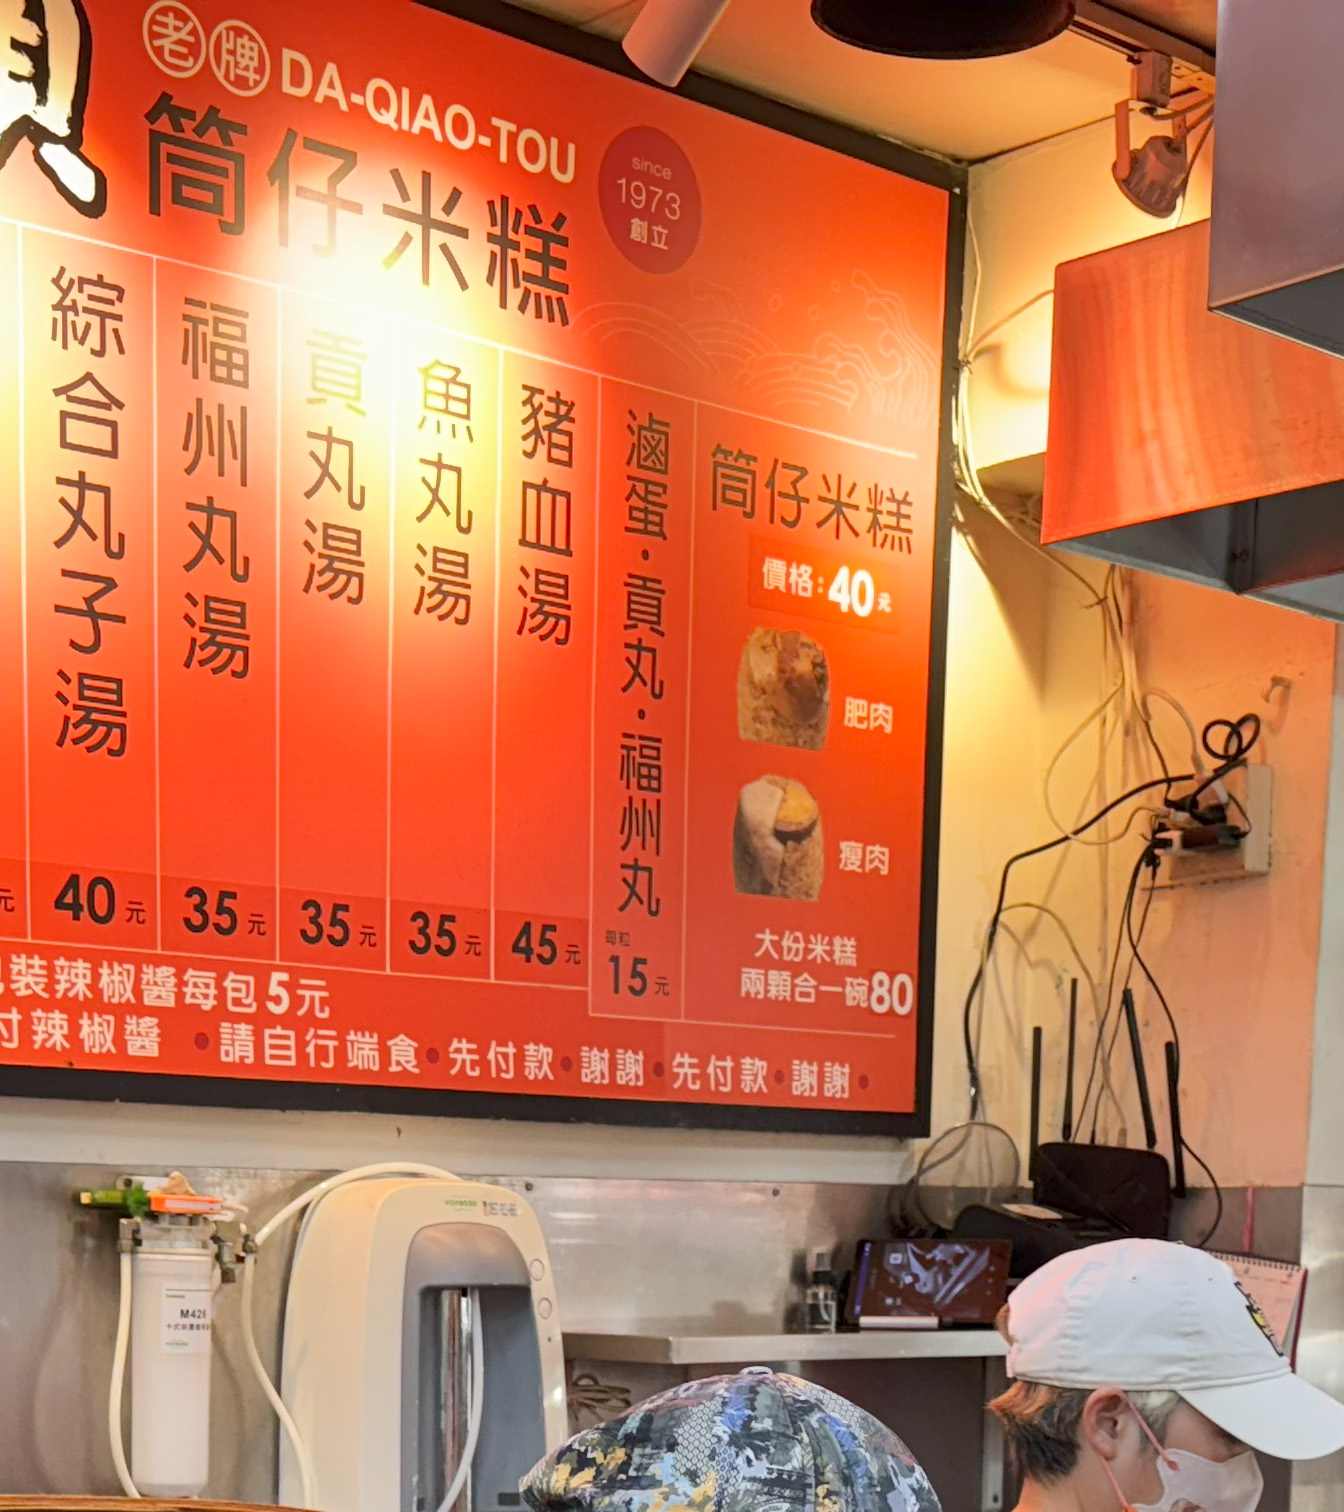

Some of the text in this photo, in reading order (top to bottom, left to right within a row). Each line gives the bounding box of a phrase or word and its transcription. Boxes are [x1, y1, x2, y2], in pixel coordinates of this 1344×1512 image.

[280, 50, 577, 184] DA-QIAO-TOU
[143, 92, 572, 327] 筒仔米糕
[615, 178, 683, 222] 1973
[631, 152, 673, 181] since
[629, 220, 670, 252] 創立
[50, 265, 129, 758] 綜合丸子湯
[182, 297, 251, 679] 福州丸湯
[302, 329, 366, 606] 貢丸湯
[413, 357, 475, 627] 魚丸湯
[516, 383, 576, 646] 豬血湯
[709, 442, 915, 555] 筒仔米糕
[843, 697, 894, 735] 肥肉
[838, 840, 891, 877] 瘦肉
[604, 929, 631, 948] 每粒
[753, 929, 858, 968] 大份米糕
[218, 1019, 422, 1077] 請自行端食
[446, 1036, 556, 1084] 先付款
[579, 1045, 647, 1089] 謝謝
[670, 1052, 771, 1095] 先付款
[789, 1057, 853, 1100] 謝謝
